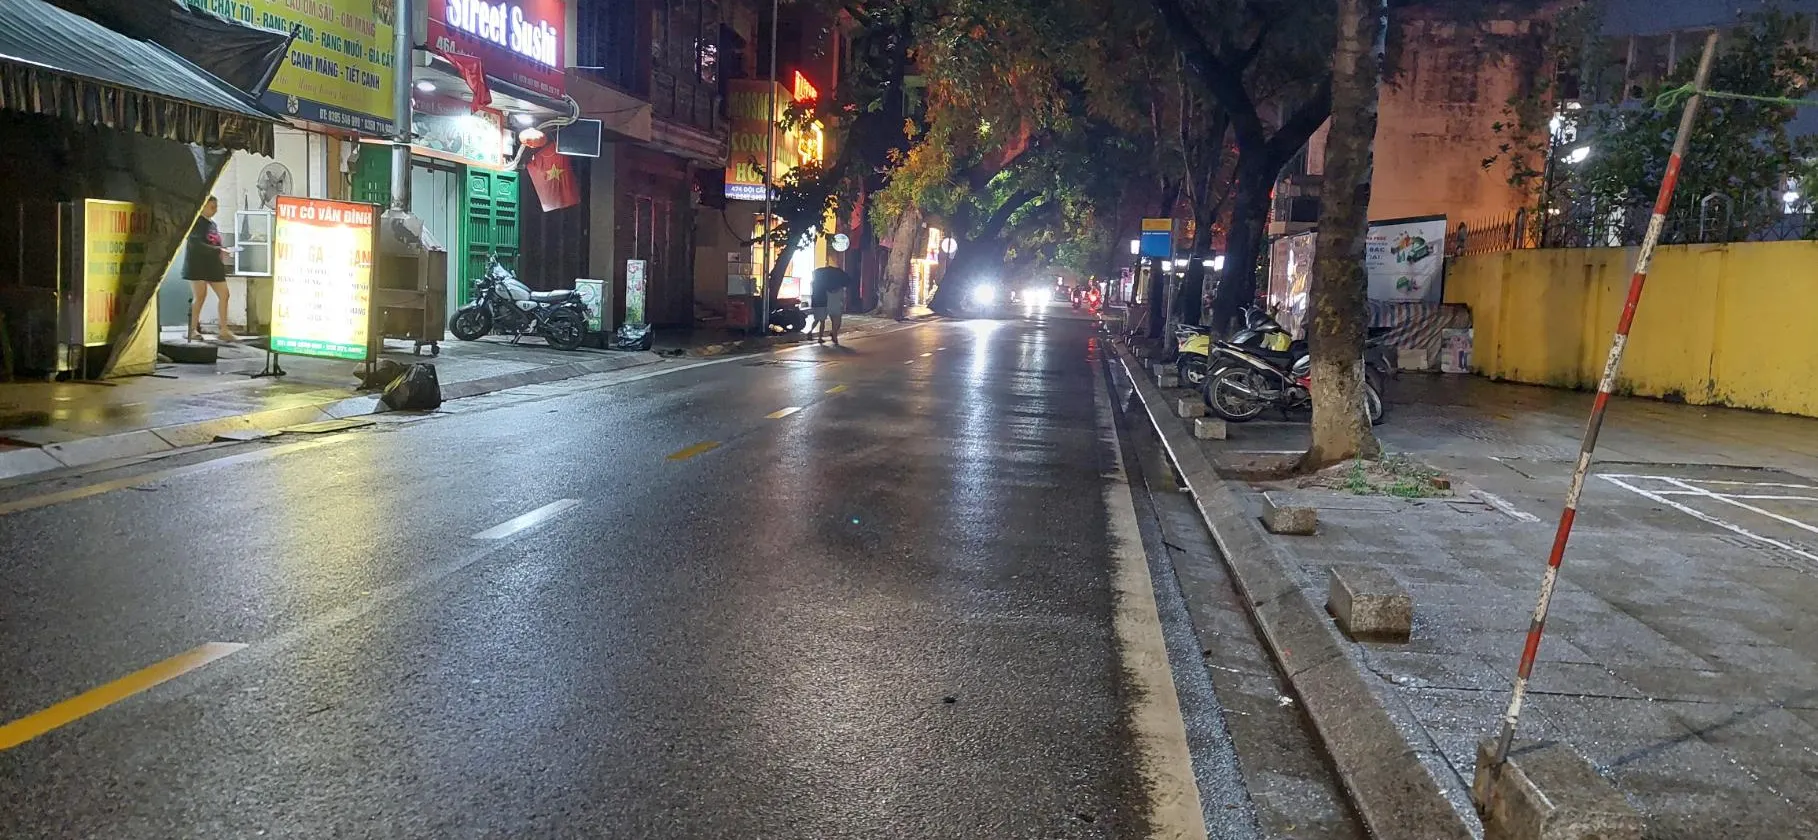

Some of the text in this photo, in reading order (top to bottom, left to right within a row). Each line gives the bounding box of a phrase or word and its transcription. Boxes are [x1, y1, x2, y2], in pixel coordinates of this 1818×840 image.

[321, 31, 342, 52] RANG
[509, 6, 557, 68] Sushi
[291, 50, 313, 71] CANH
[362, 70, 380, 90] CANH
